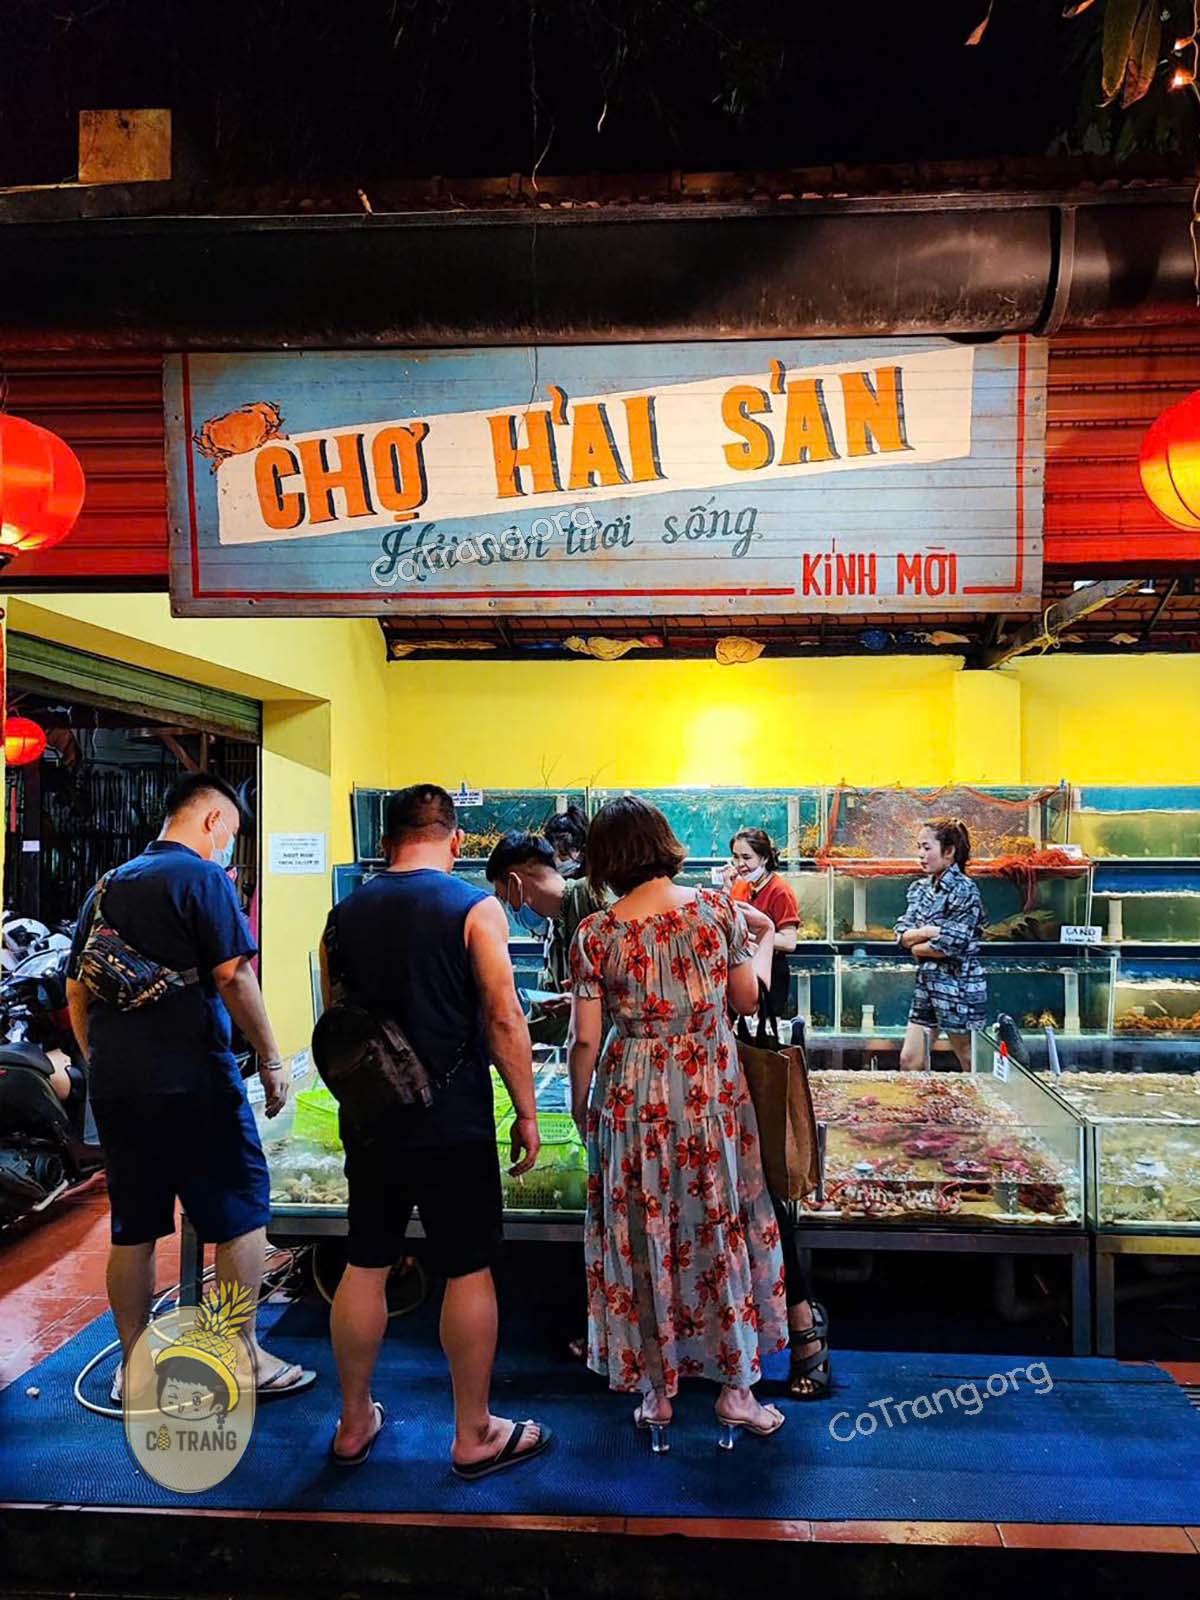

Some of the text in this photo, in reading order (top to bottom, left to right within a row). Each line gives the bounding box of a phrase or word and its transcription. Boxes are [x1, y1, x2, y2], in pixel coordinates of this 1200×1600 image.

[255, 358, 915, 530] CHỢ HẢI SẢN
[661, 496, 763, 558] sống
